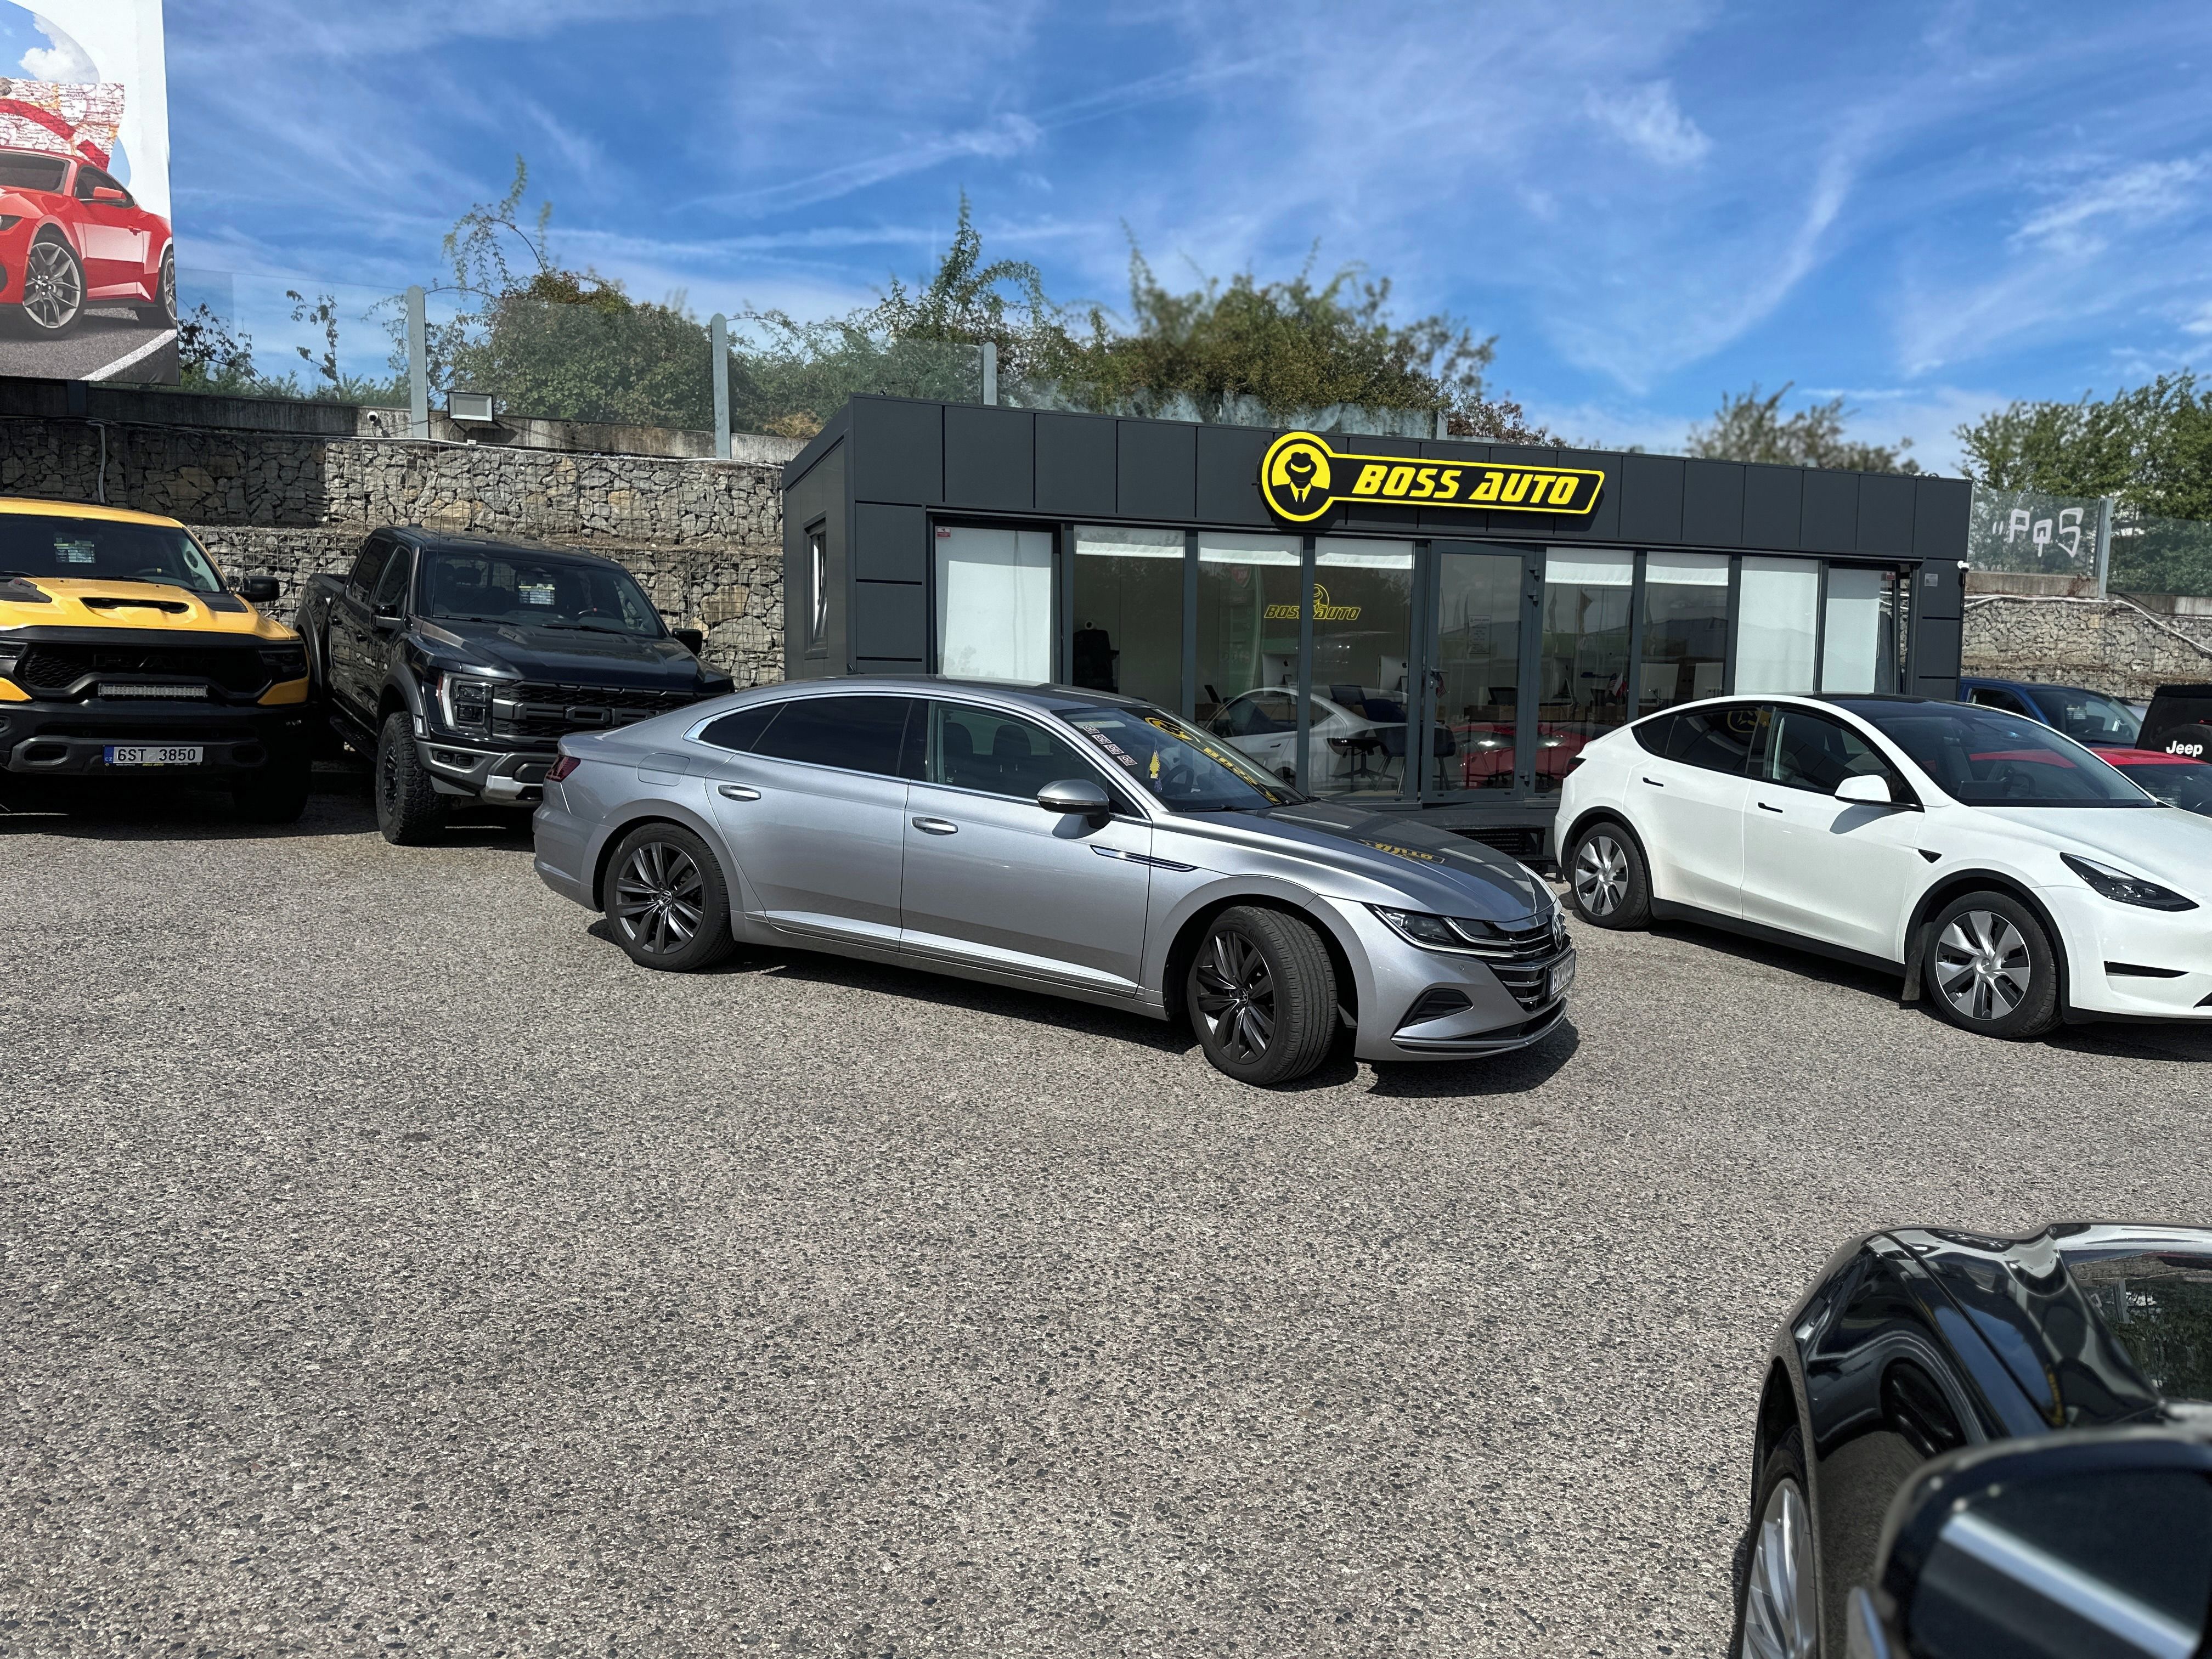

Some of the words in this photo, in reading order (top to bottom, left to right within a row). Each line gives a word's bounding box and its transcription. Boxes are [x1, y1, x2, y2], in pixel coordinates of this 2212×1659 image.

[1352, 464, 1462, 499] BOSS
[1468, 471, 1579, 505] AUTO
[1263, 605, 1300, 619] BOS
[117, 748, 146, 761] 6ST
[159, 748, 196, 761] 3850
[2165, 740, 2203, 758] Jeep
